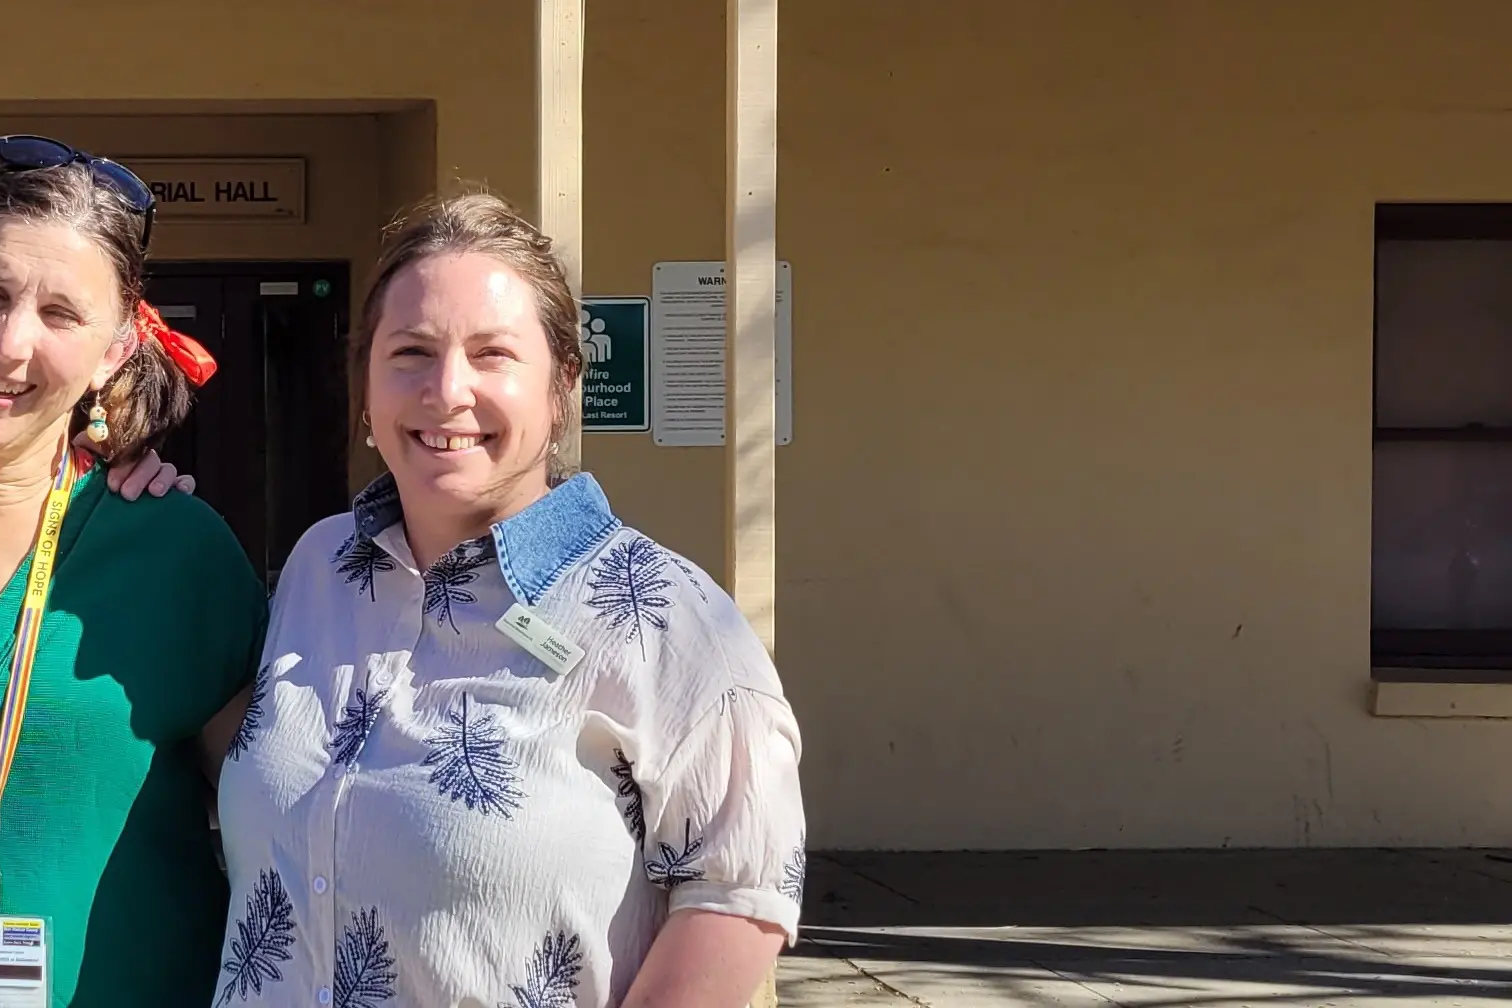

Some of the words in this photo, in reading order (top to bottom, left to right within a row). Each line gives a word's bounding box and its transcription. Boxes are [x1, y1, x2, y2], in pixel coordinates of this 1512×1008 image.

[215, 181, 279, 202] HALL
[585, 395, 619, 407] Place
[600, 411, 628, 419] Resort
[45, 500, 63, 536] SIGNS
[41, 540, 54, 557] OF
[32, 561, 49, 597] HOPE
